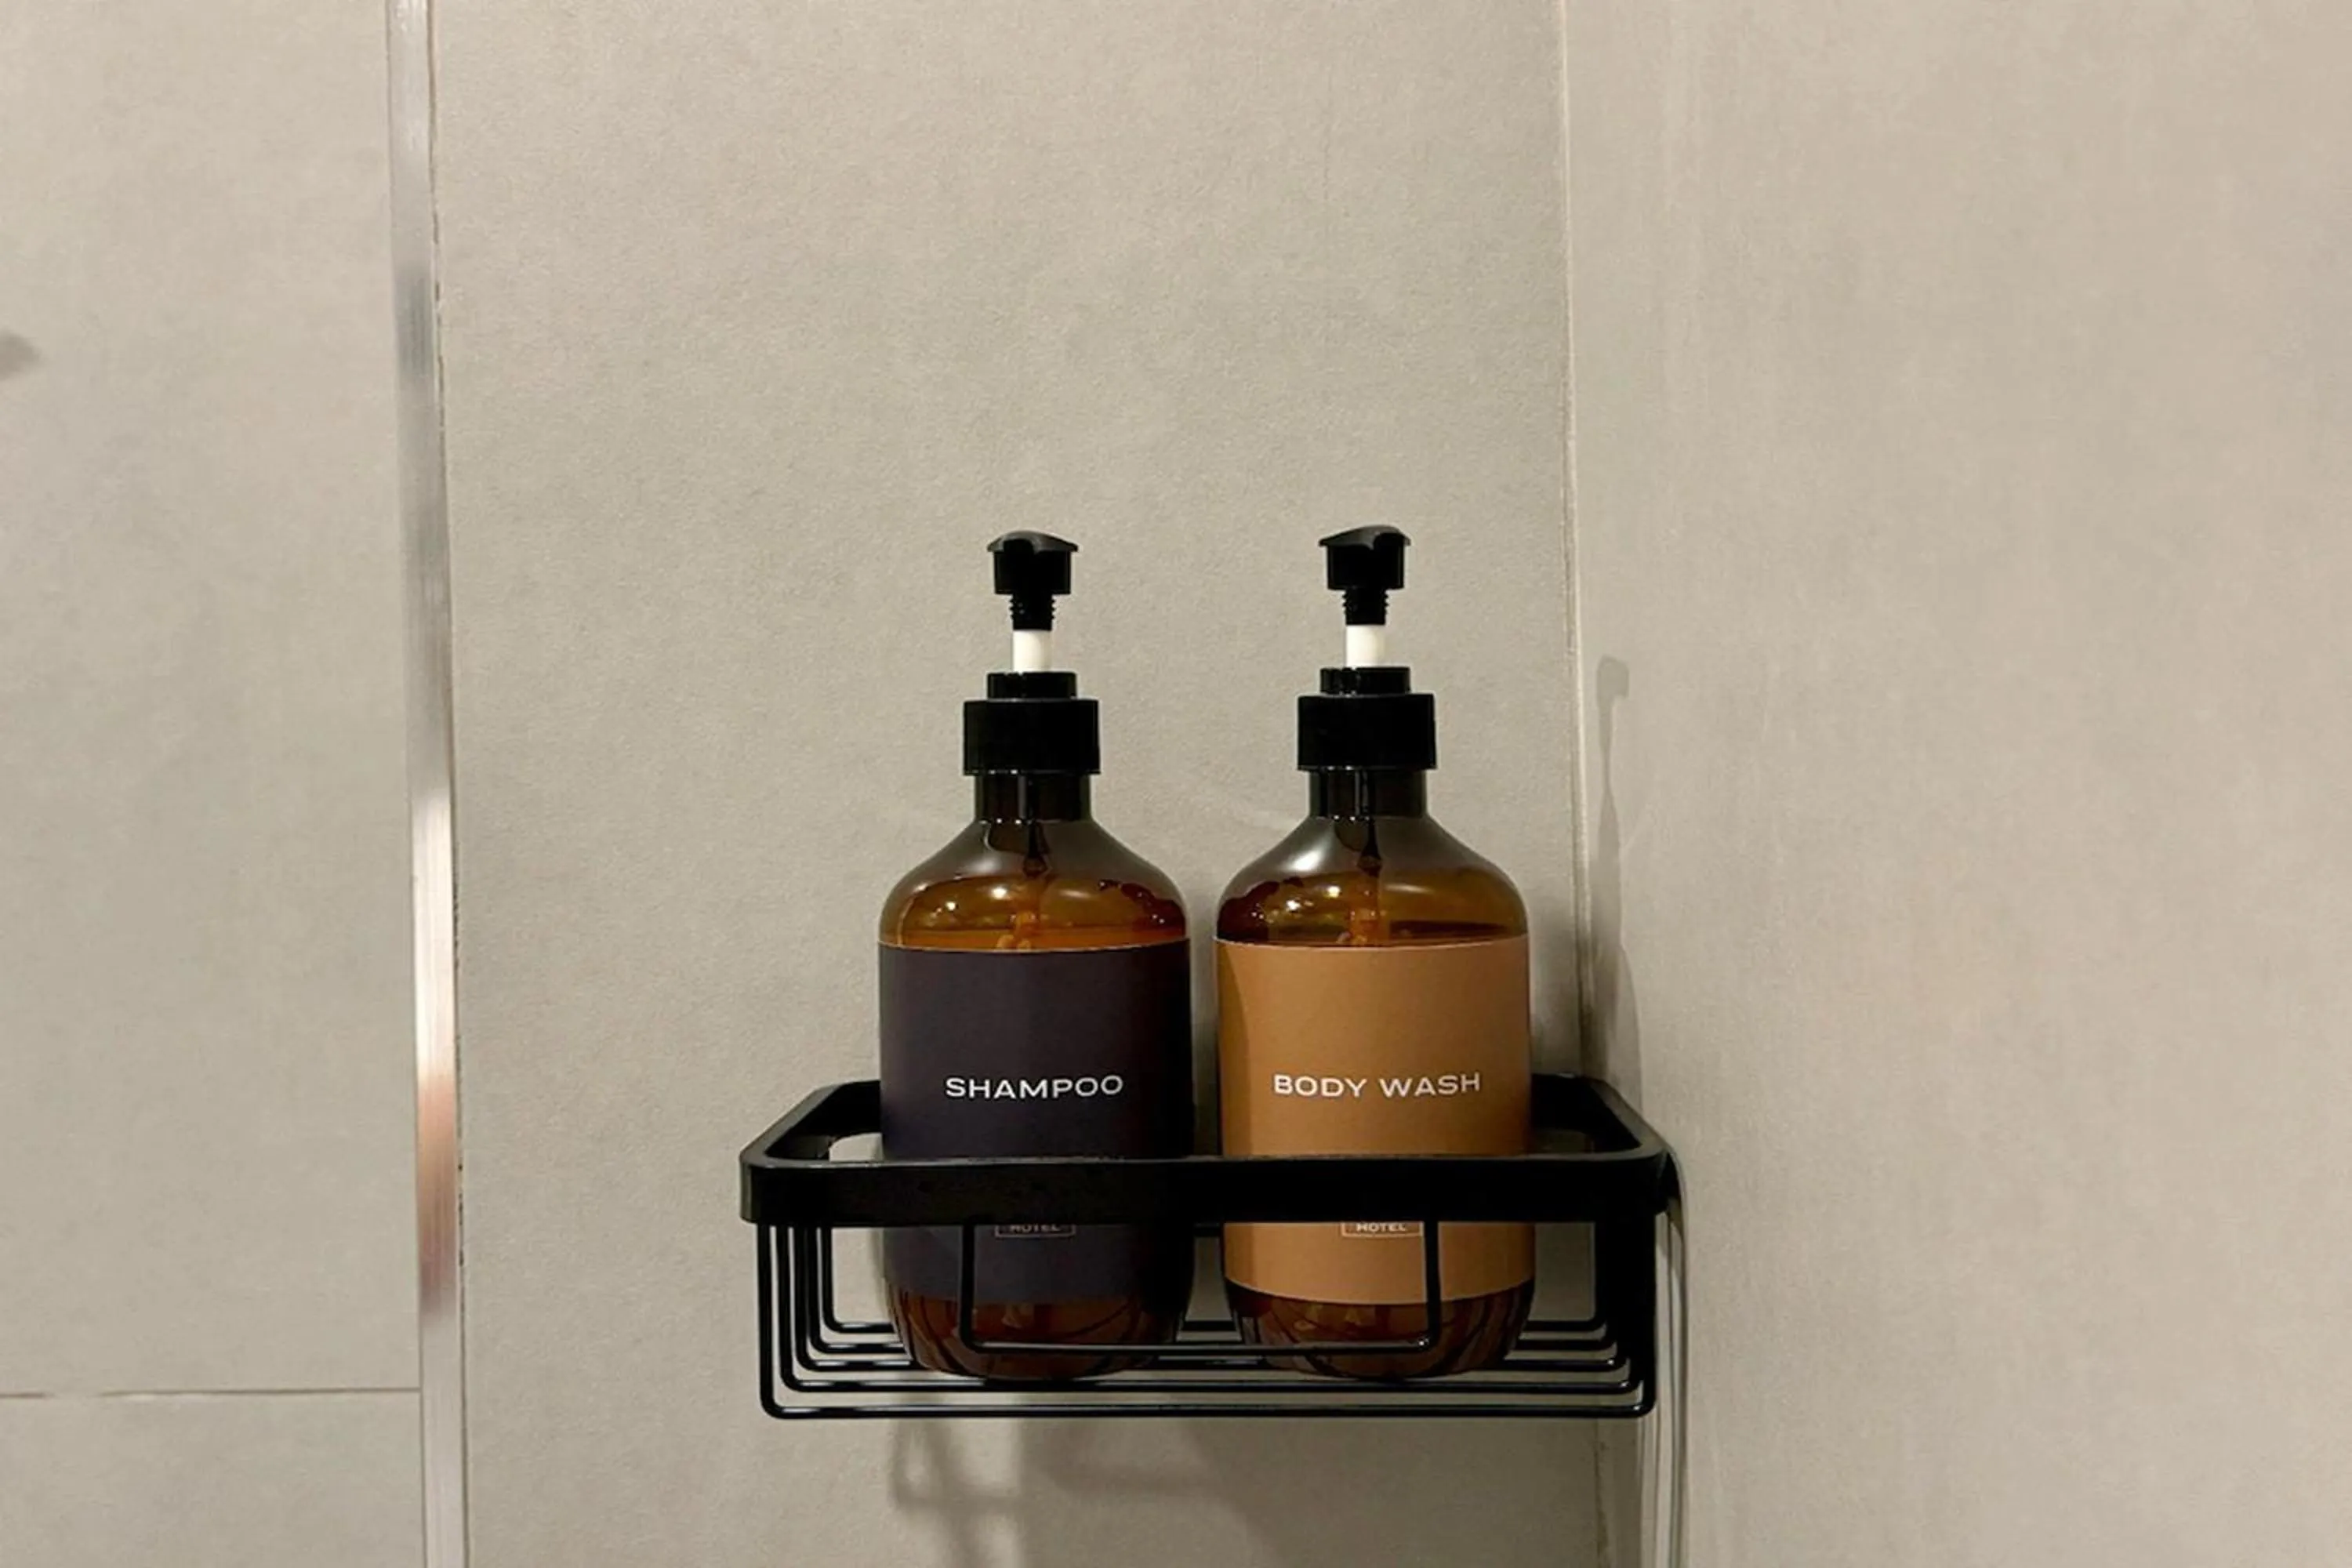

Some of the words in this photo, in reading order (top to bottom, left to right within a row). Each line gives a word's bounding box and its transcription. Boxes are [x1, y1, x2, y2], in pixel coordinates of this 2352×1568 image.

[946, 1074, 1123, 1099] SHAMPOO
[1273, 1074, 1367, 1098] BODY
[1379, 1072, 1480, 1098] WASH
[1356, 1222, 1406, 1232] HOTEL
